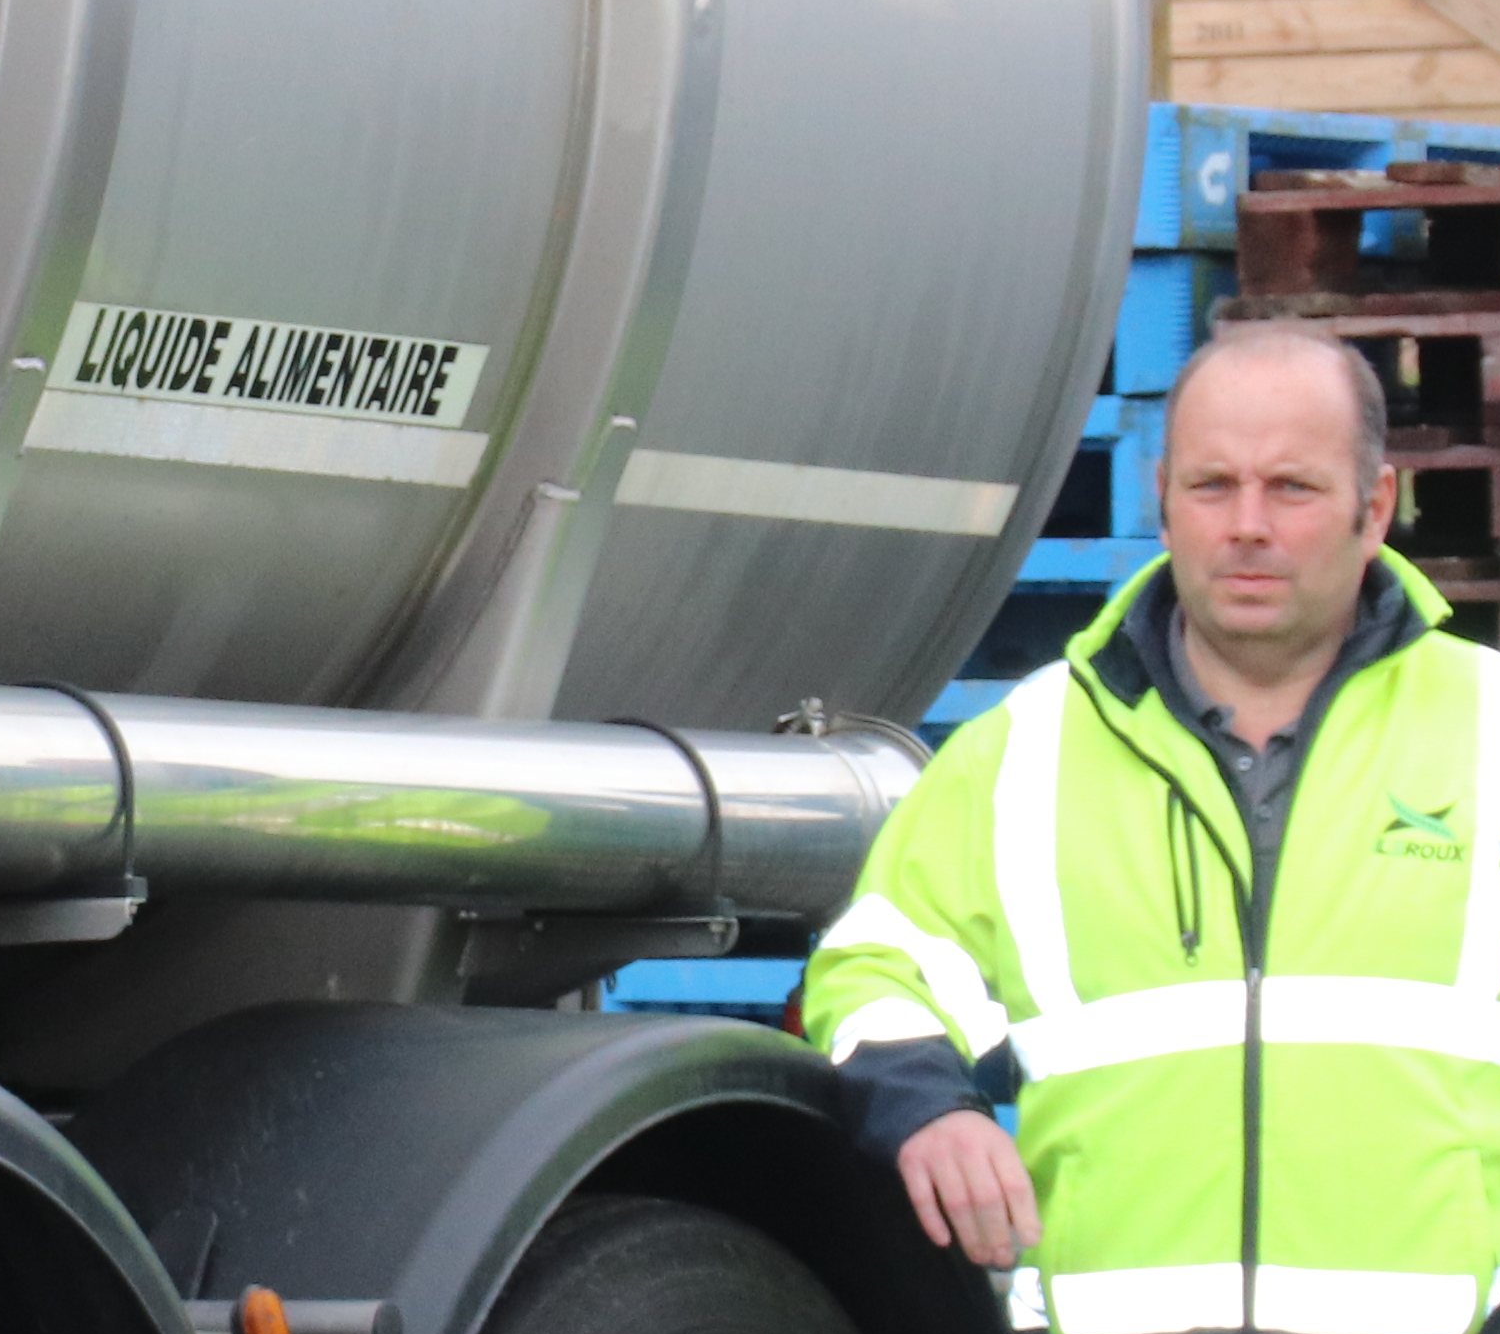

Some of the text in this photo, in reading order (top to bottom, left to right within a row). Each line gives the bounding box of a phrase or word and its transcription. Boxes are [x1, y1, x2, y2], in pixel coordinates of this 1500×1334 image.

[74, 307, 460, 417] LIQUIDE ALIMENTAIRE
[1374, 836, 1467, 863] LROUX
